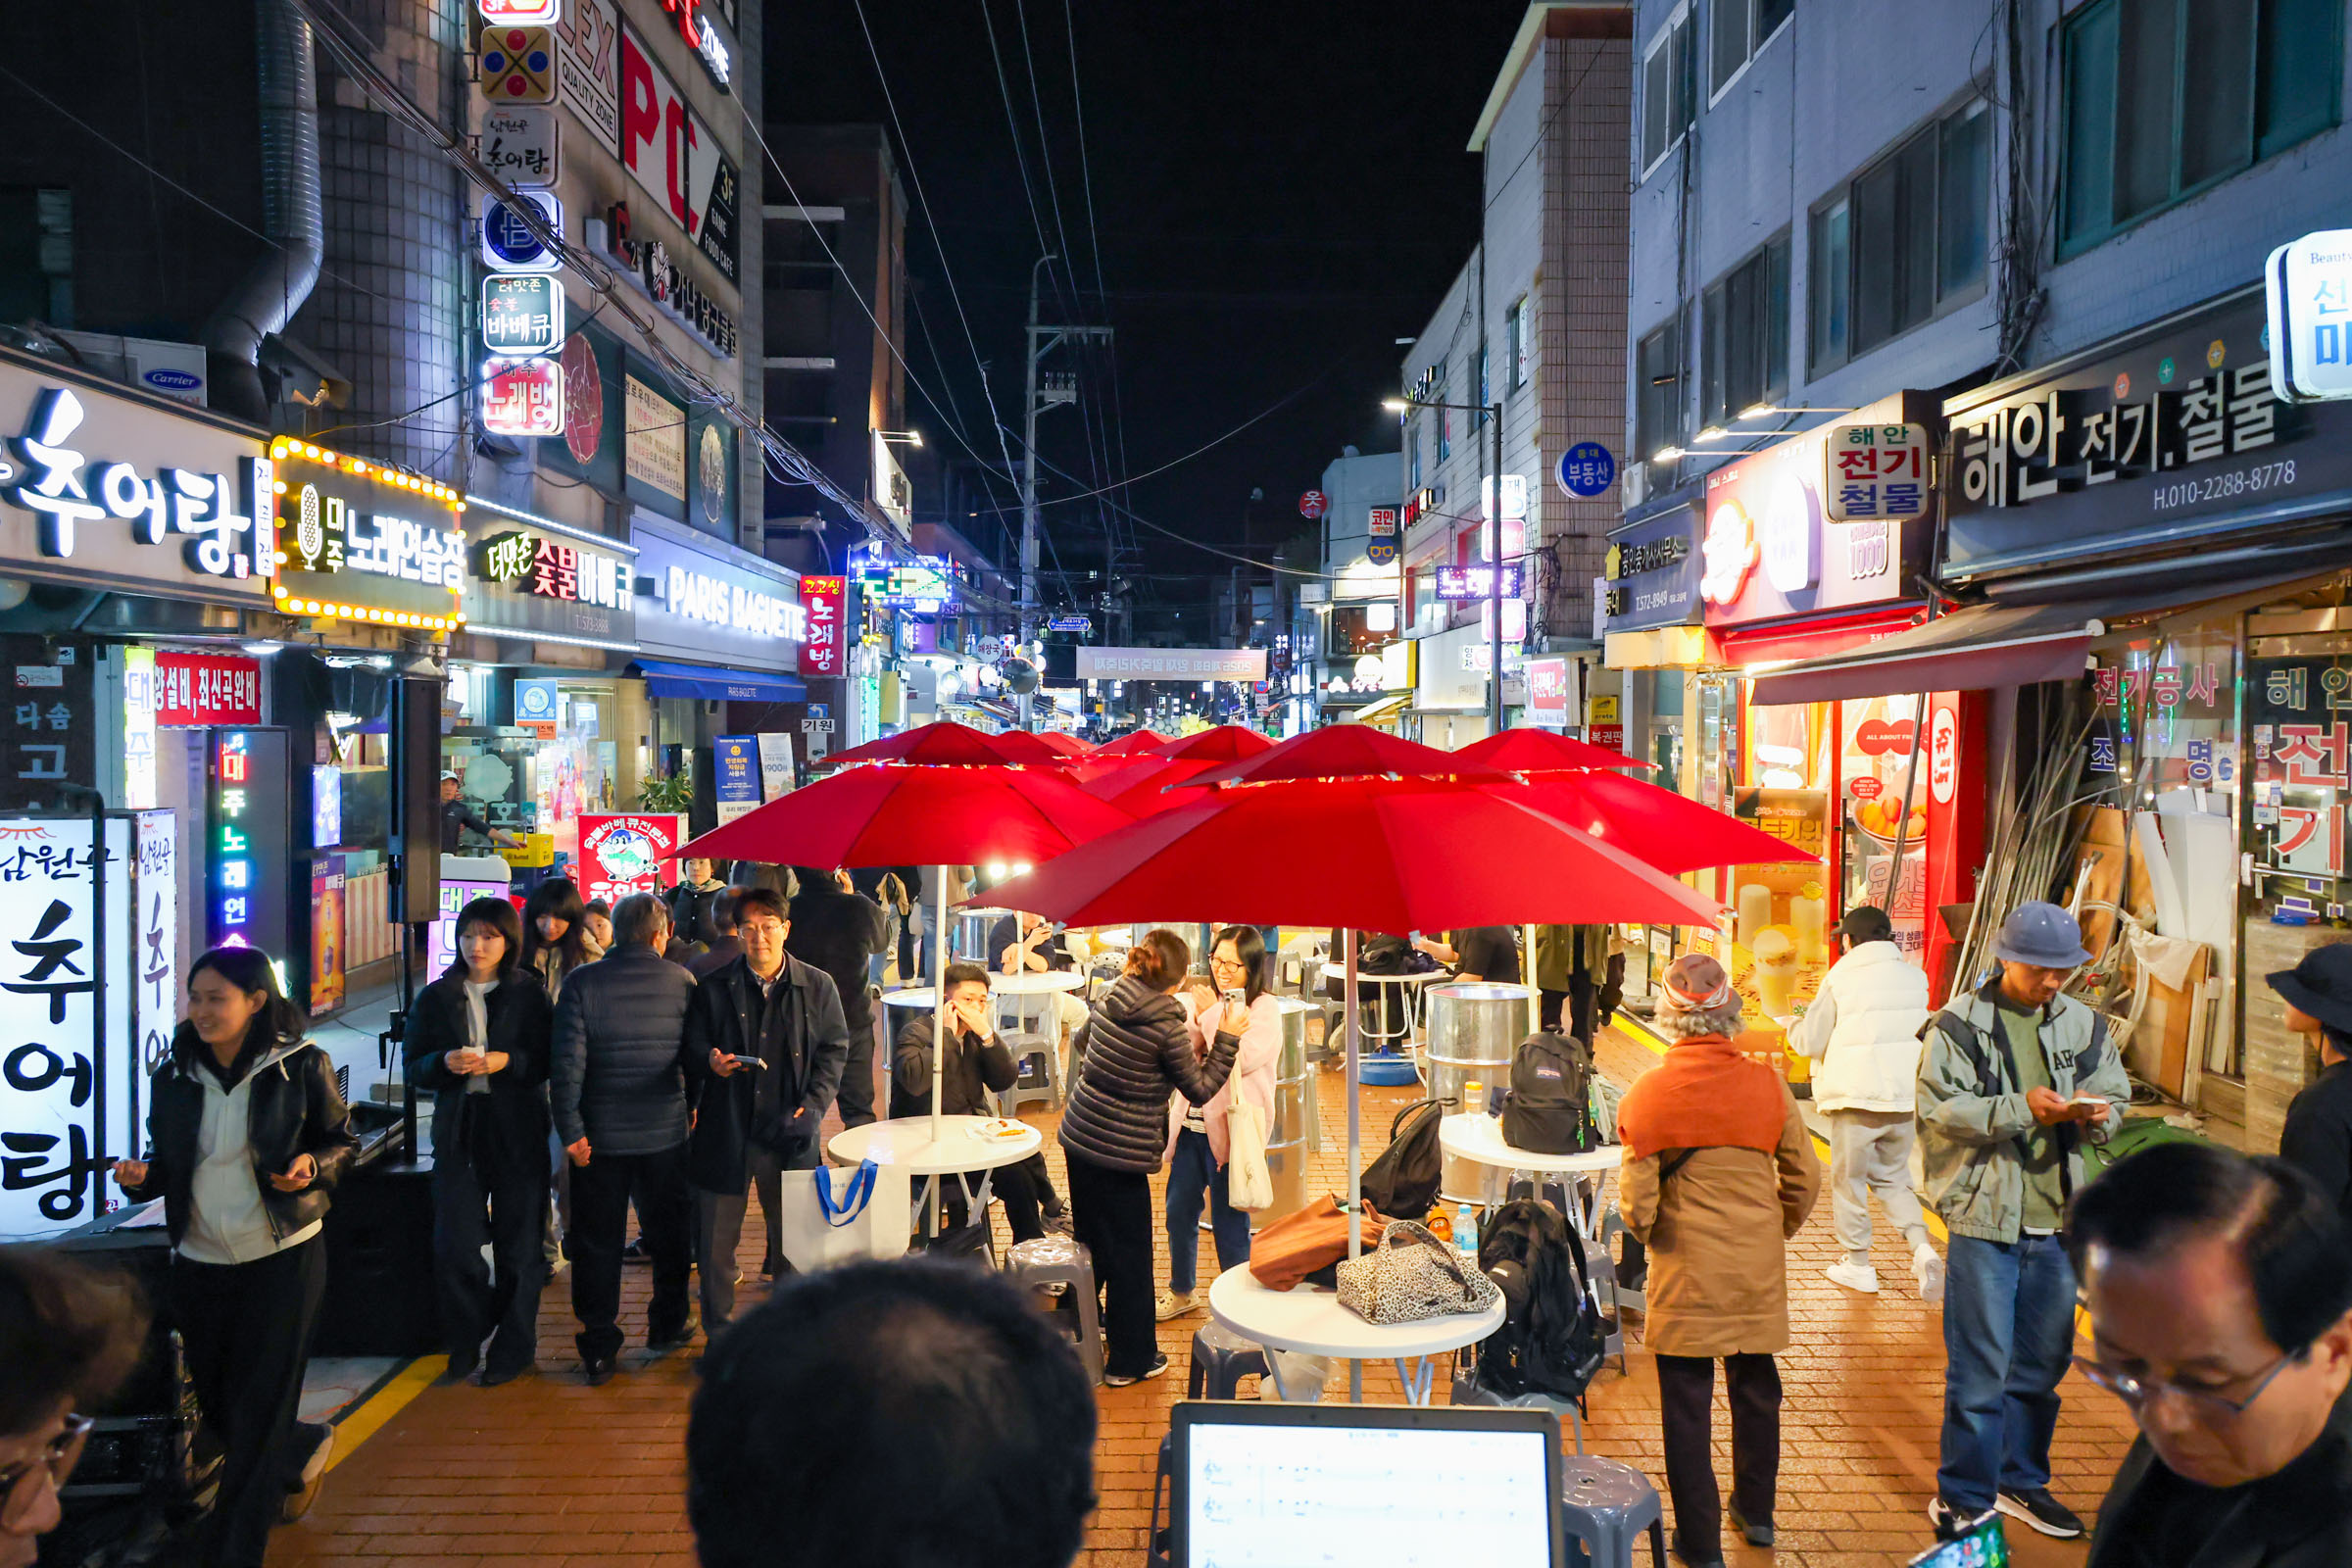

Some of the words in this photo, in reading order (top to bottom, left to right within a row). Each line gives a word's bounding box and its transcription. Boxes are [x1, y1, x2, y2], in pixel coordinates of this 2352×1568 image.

[563, 63, 594, 108] QUALITY
[595, 100, 613, 131] ZONE
[623, 33, 701, 235] PC
[485, 137, 549, 174] 추어탕
[721, 165, 734, 205] 3F
[711, 208, 727, 238] GAME
[705, 233, 719, 262] FOOD
[719, 250, 733, 276] CAFE
[498, 278, 542, 293] 더맛존
[487, 312, 552, 344] 바베큐
[151, 372, 196, 387] Carrier
[489, 380, 553, 425] 노래방
[1848, 425, 1910, 446] 해안
[1964, 390, 2065, 508] 해안
[15, 389, 251, 575] 추어탕
[1569, 462, 1608, 487] 부동산
[1838, 447, 1921, 480] 전기
[1304, 491, 1323, 508] 옷
[1838, 483, 1924, 515] 철물
[2154, 459, 2296, 511] H.010-2288-8778
[326, 497, 345, 573] 대주
[1371, 511, 1394, 525] 코인
[347, 509, 466, 588] 노래연습장
[1622, 536, 1687, 576] 공인중개사사무소
[488, 532, 533, 582] 더맛존
[534, 538, 577, 601] 숯불
[577, 552, 634, 612] 바베큐
[804, 579, 841, 596] 고고싱
[669, 565, 729, 626] PARIS
[731, 587, 807, 643] BAGUETTE
[808, 597, 835, 671] 노래방
[2093, 662, 2219, 708] 전기공사
[16, 701, 73, 731] 다솜
[803, 719, 833, 732] 기원
[1, 899, 120, 1222] 추어탕
